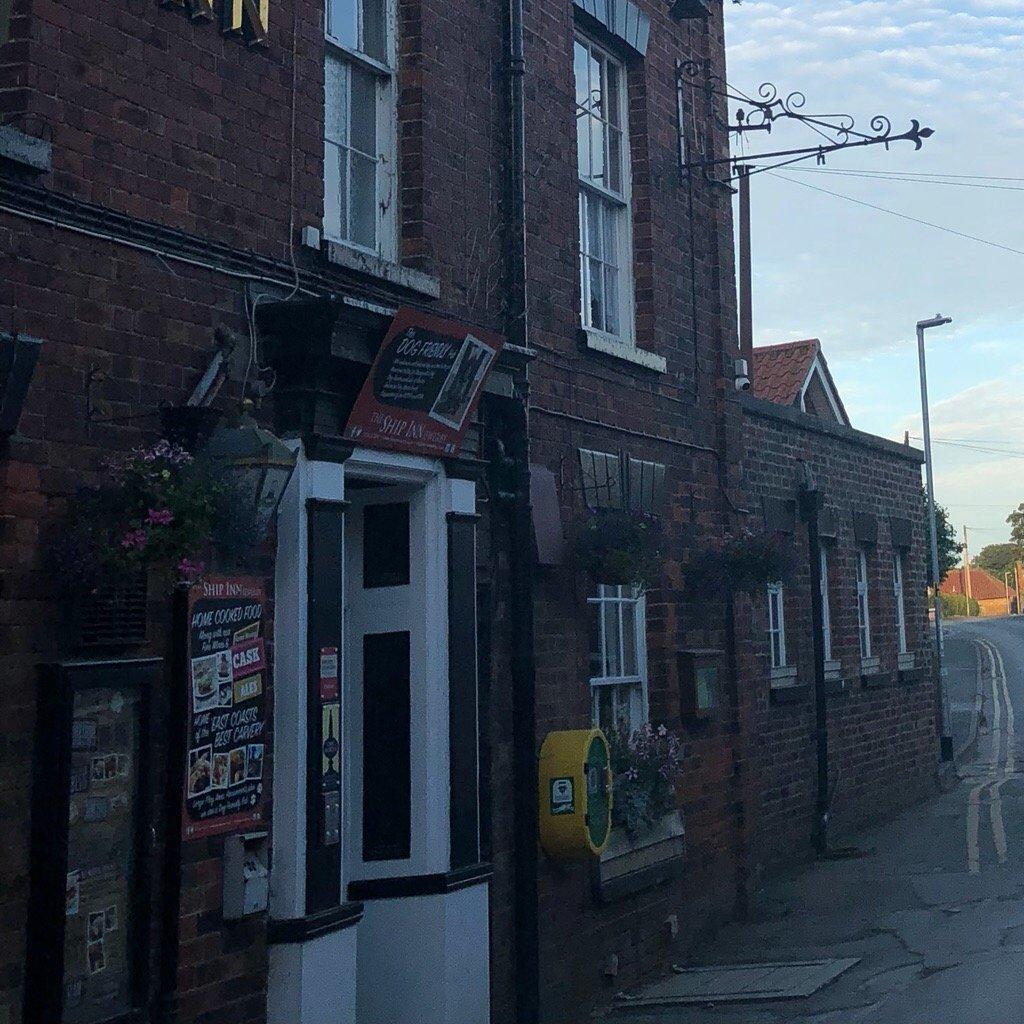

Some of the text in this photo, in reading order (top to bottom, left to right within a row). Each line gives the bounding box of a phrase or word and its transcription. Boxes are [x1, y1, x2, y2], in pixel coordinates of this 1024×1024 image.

[396, 338, 422, 356] DOG
[379, 414, 407, 436] SHIP
[405, 420, 425, 439] INN
[203, 582, 224, 597] SHIP
[226, 582, 242, 596] INN
[191, 604, 262, 628] HOME COOKED FOOD
[233, 647, 260, 669] CASK
[211, 706, 259, 732] EAST COASTS
[214, 720, 265, 748] BEST CARVERY
